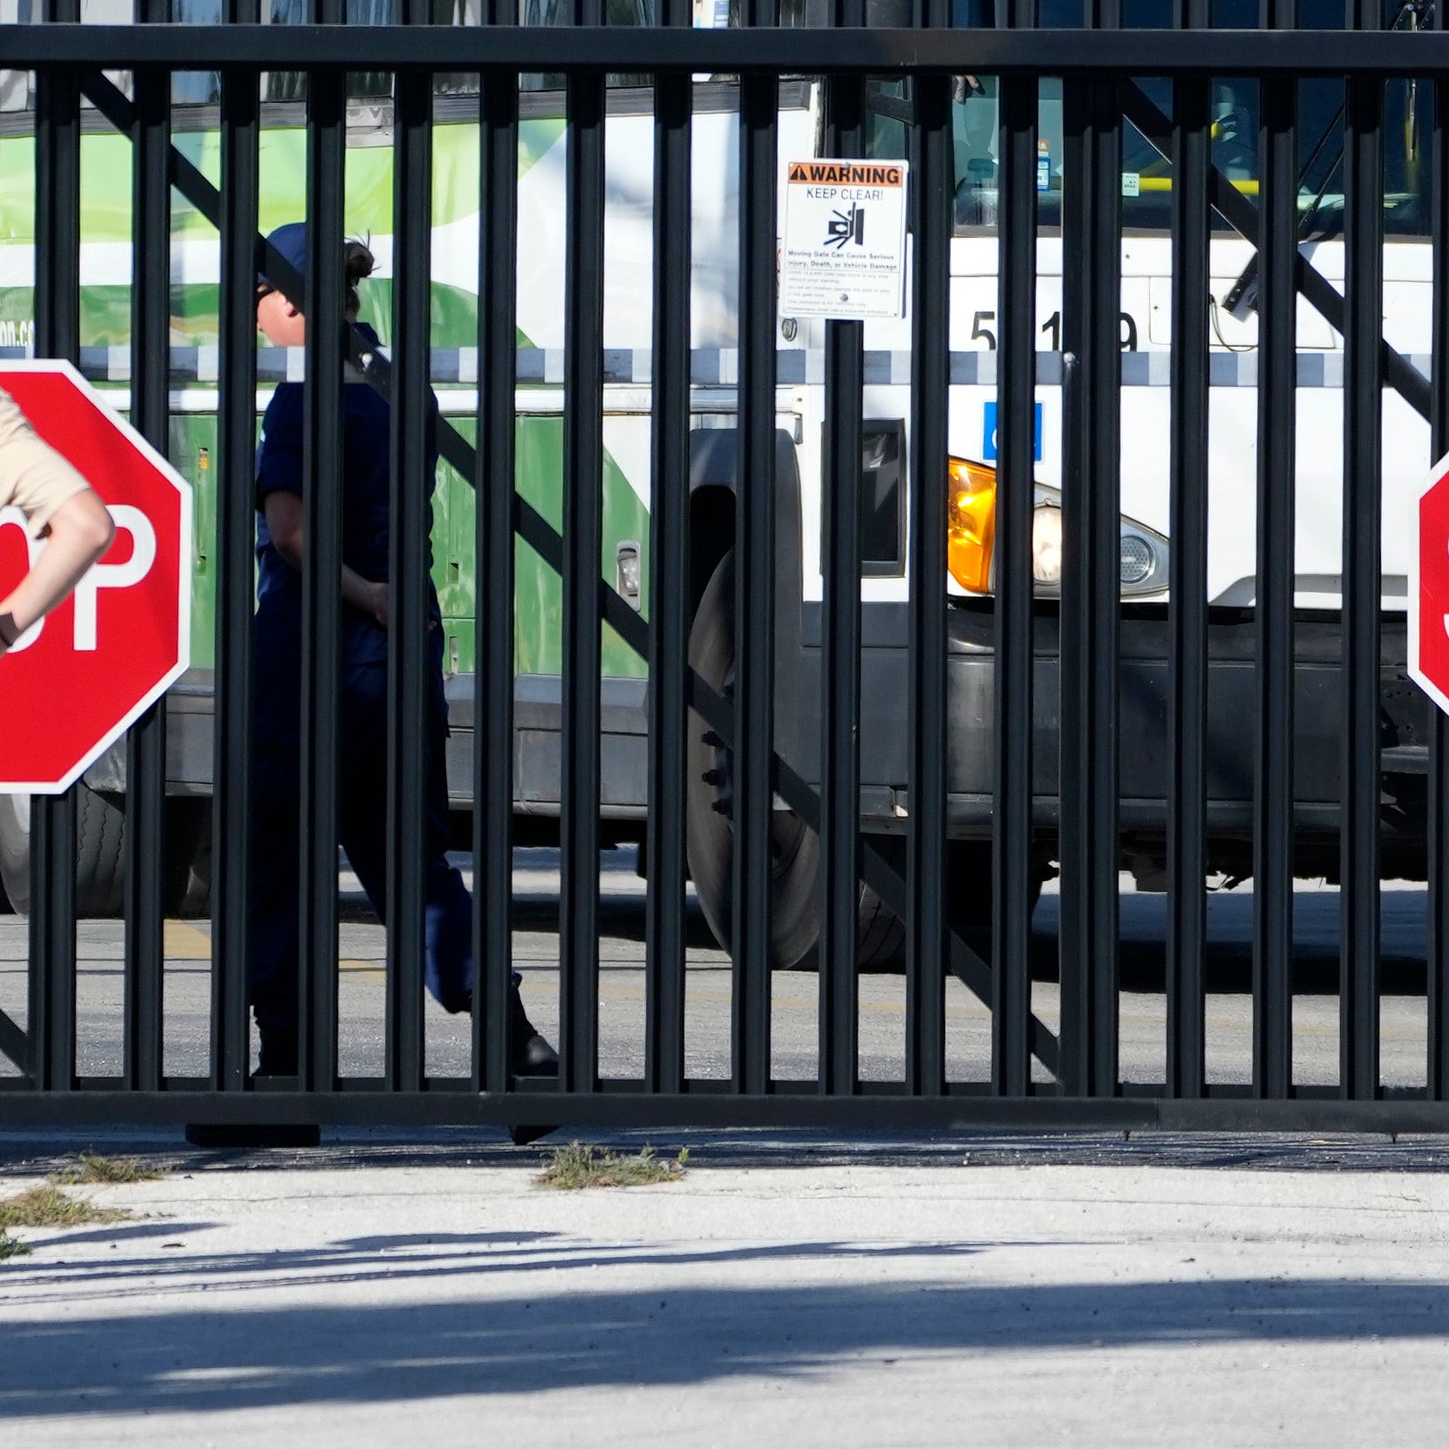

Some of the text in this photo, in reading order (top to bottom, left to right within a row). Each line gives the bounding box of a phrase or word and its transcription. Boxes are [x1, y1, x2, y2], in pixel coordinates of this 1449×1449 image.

[809, 165, 900, 184] WARNING
[806, 187, 884, 201] KEEP CLEAR!
